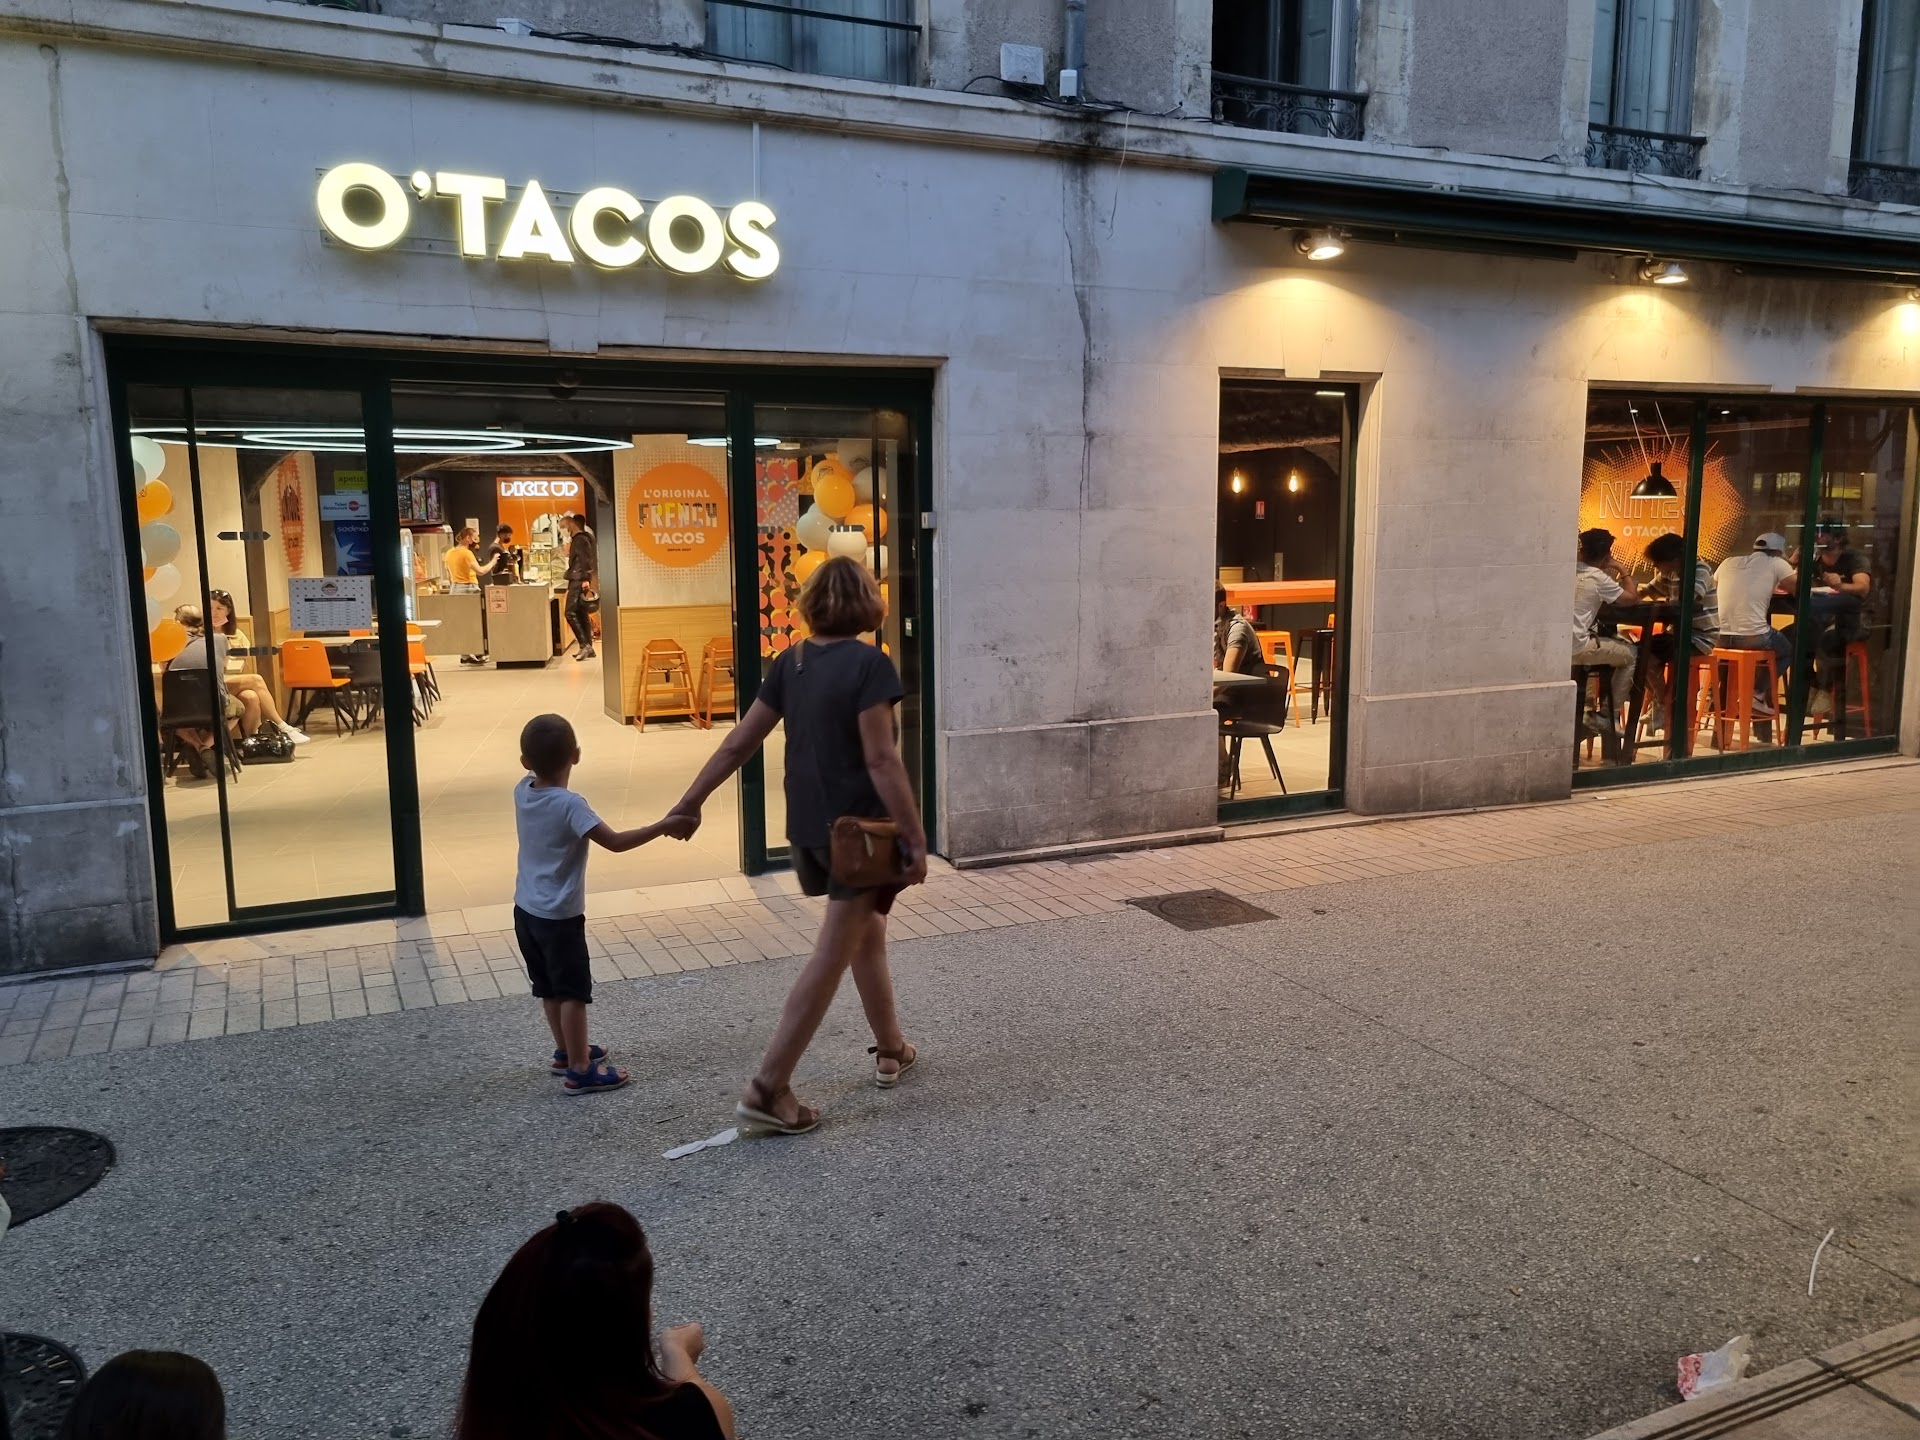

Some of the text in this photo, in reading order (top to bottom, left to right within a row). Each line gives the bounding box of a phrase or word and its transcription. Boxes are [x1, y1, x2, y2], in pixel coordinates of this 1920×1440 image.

[317, 162, 781, 280] O'TACOS
[501, 480, 579, 497] PICK UP
[643, 489, 711, 499] L'ORIGINAL
[638, 502, 718, 529] FRENCH
[652, 531, 706, 545] TACOS
